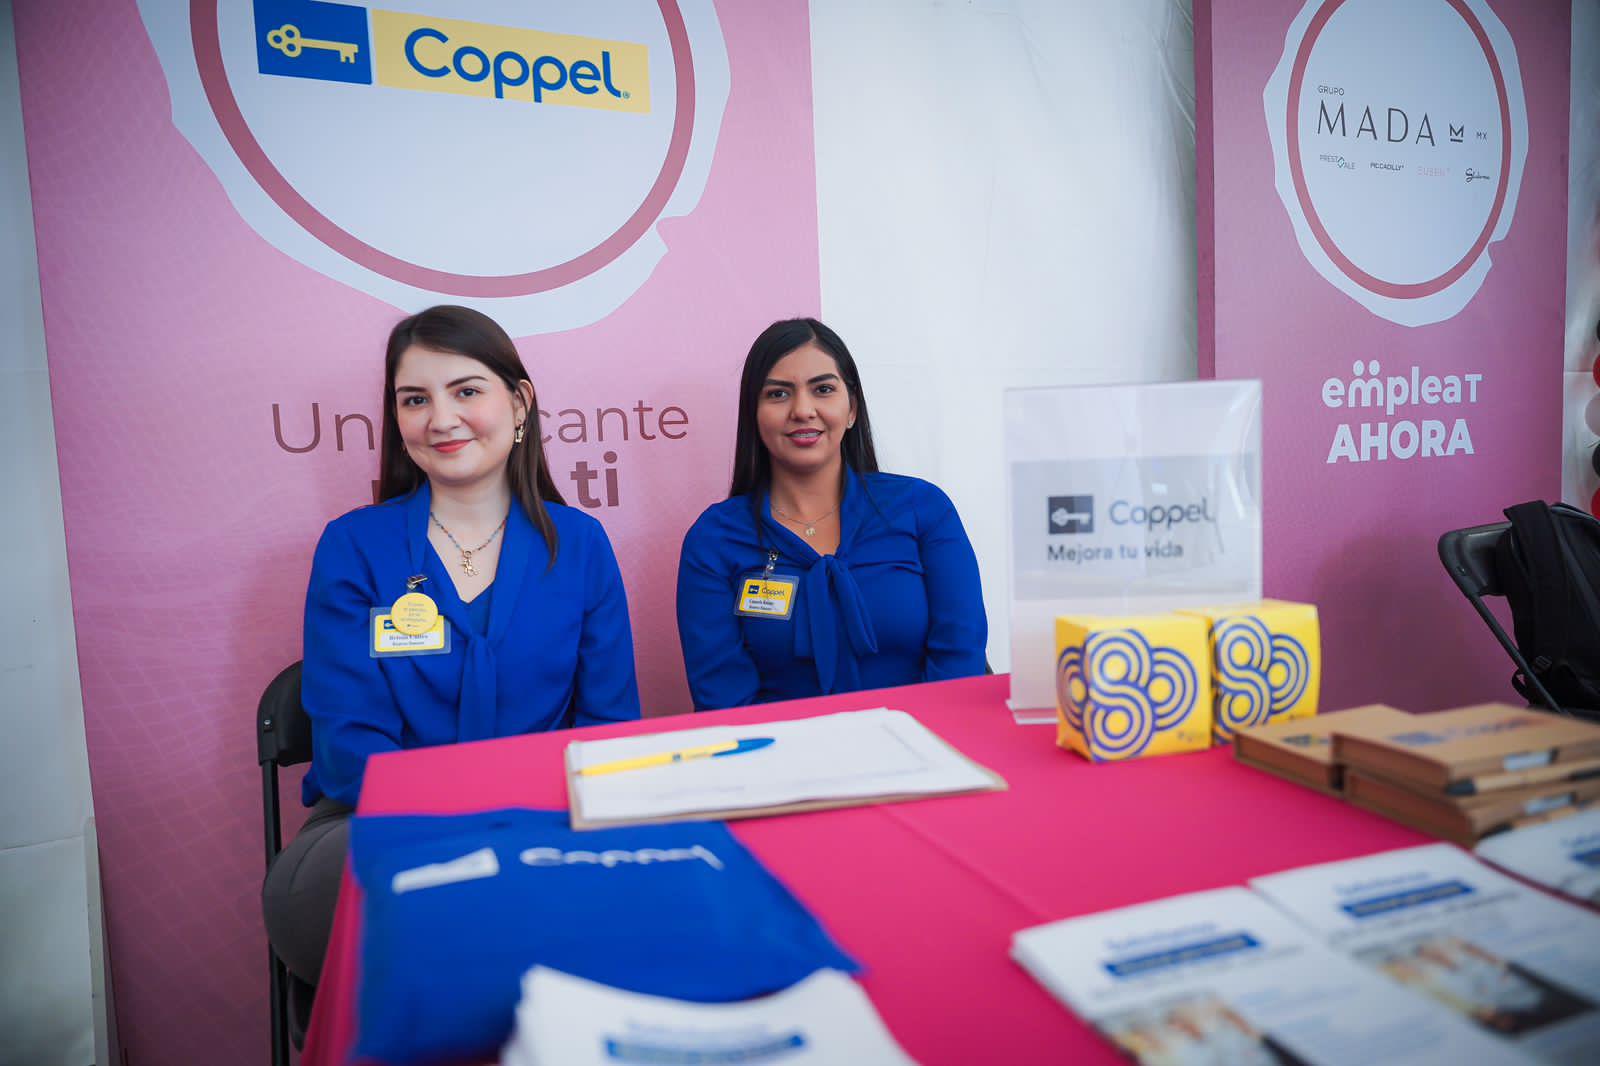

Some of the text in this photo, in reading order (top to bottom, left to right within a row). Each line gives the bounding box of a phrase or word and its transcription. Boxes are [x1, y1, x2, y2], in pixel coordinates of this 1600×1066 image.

[1318, 85, 1345, 96] GRUPO
[1317, 99, 1436, 147] MADA
[1476, 131, 1488, 141] MX
[272, 403, 376, 453] Un
[1326, 419, 1475, 464] AHORA
[570, 451, 620, 508] ti
[1108, 498, 1215, 532] Coppel
[1047, 541, 1184, 564] Mejora tu vida
